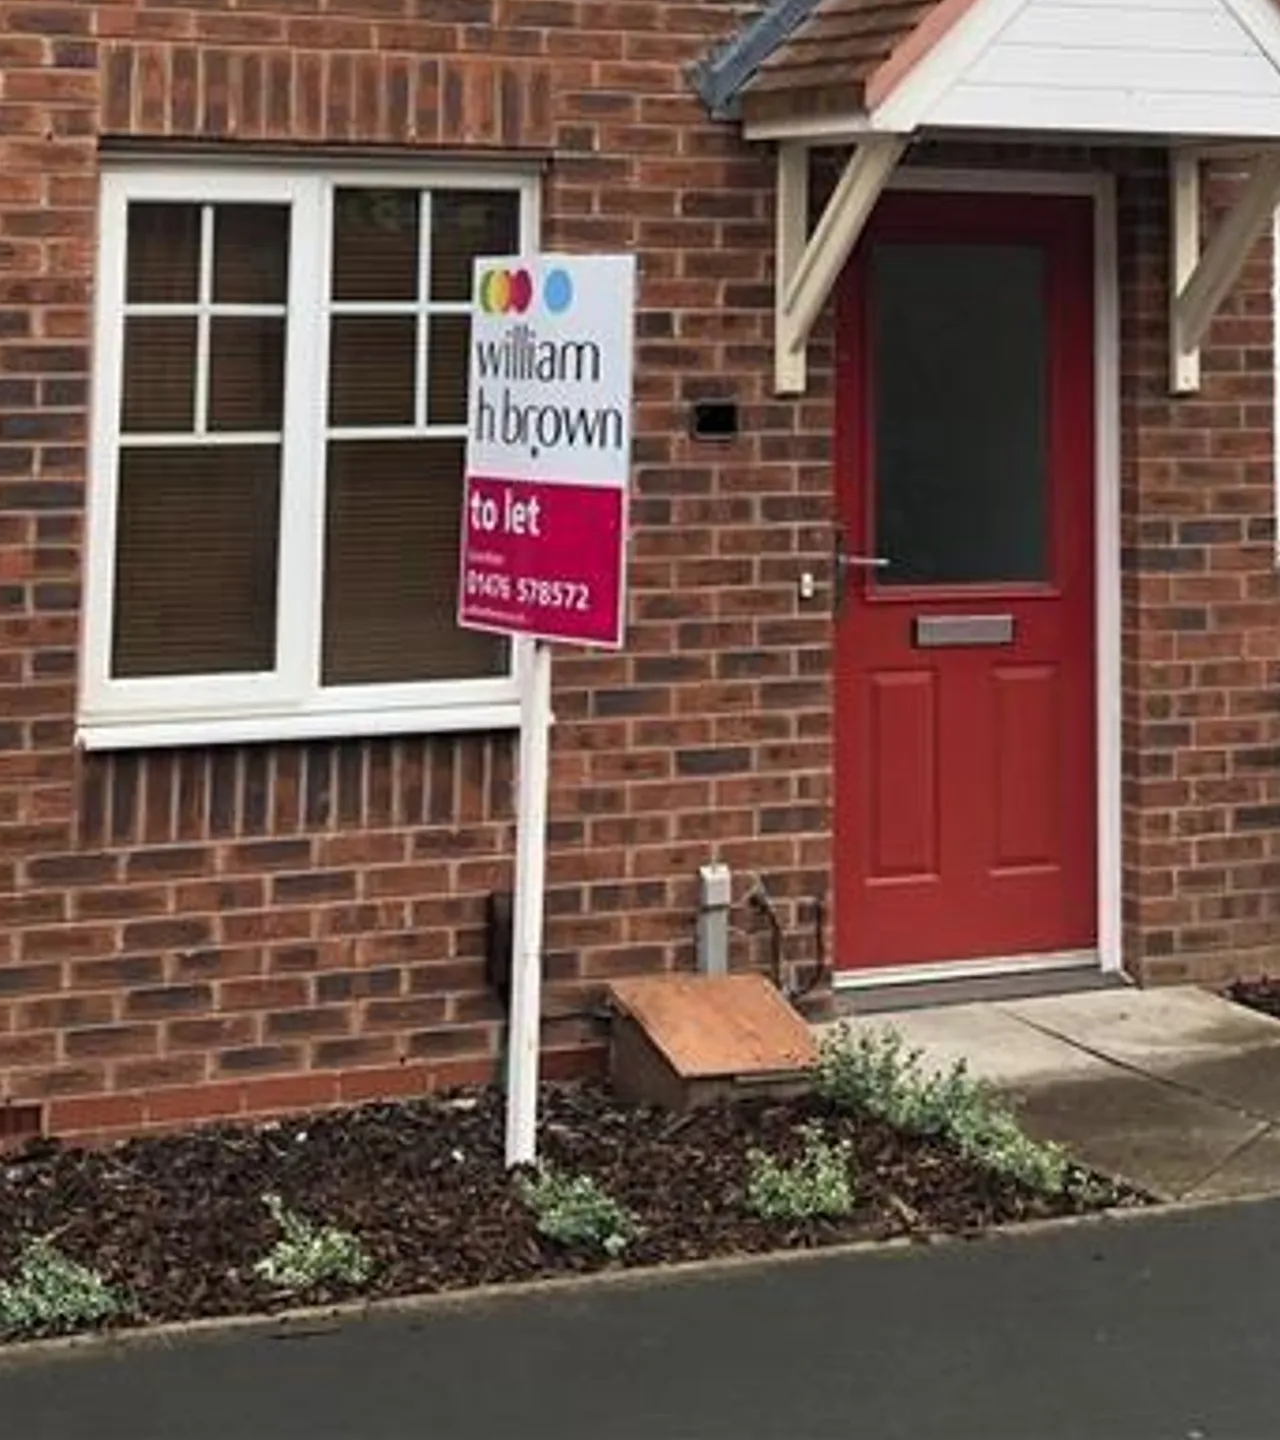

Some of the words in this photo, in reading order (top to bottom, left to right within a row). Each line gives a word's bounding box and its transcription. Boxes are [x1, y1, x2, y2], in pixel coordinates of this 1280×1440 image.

[477, 325, 601, 382] william
[476, 386, 495, 442] h
[502, 387, 623, 449] brown
[471, 491, 498, 531] to
[504, 488, 541, 537] let
[516, 577, 590, 611] 578572
